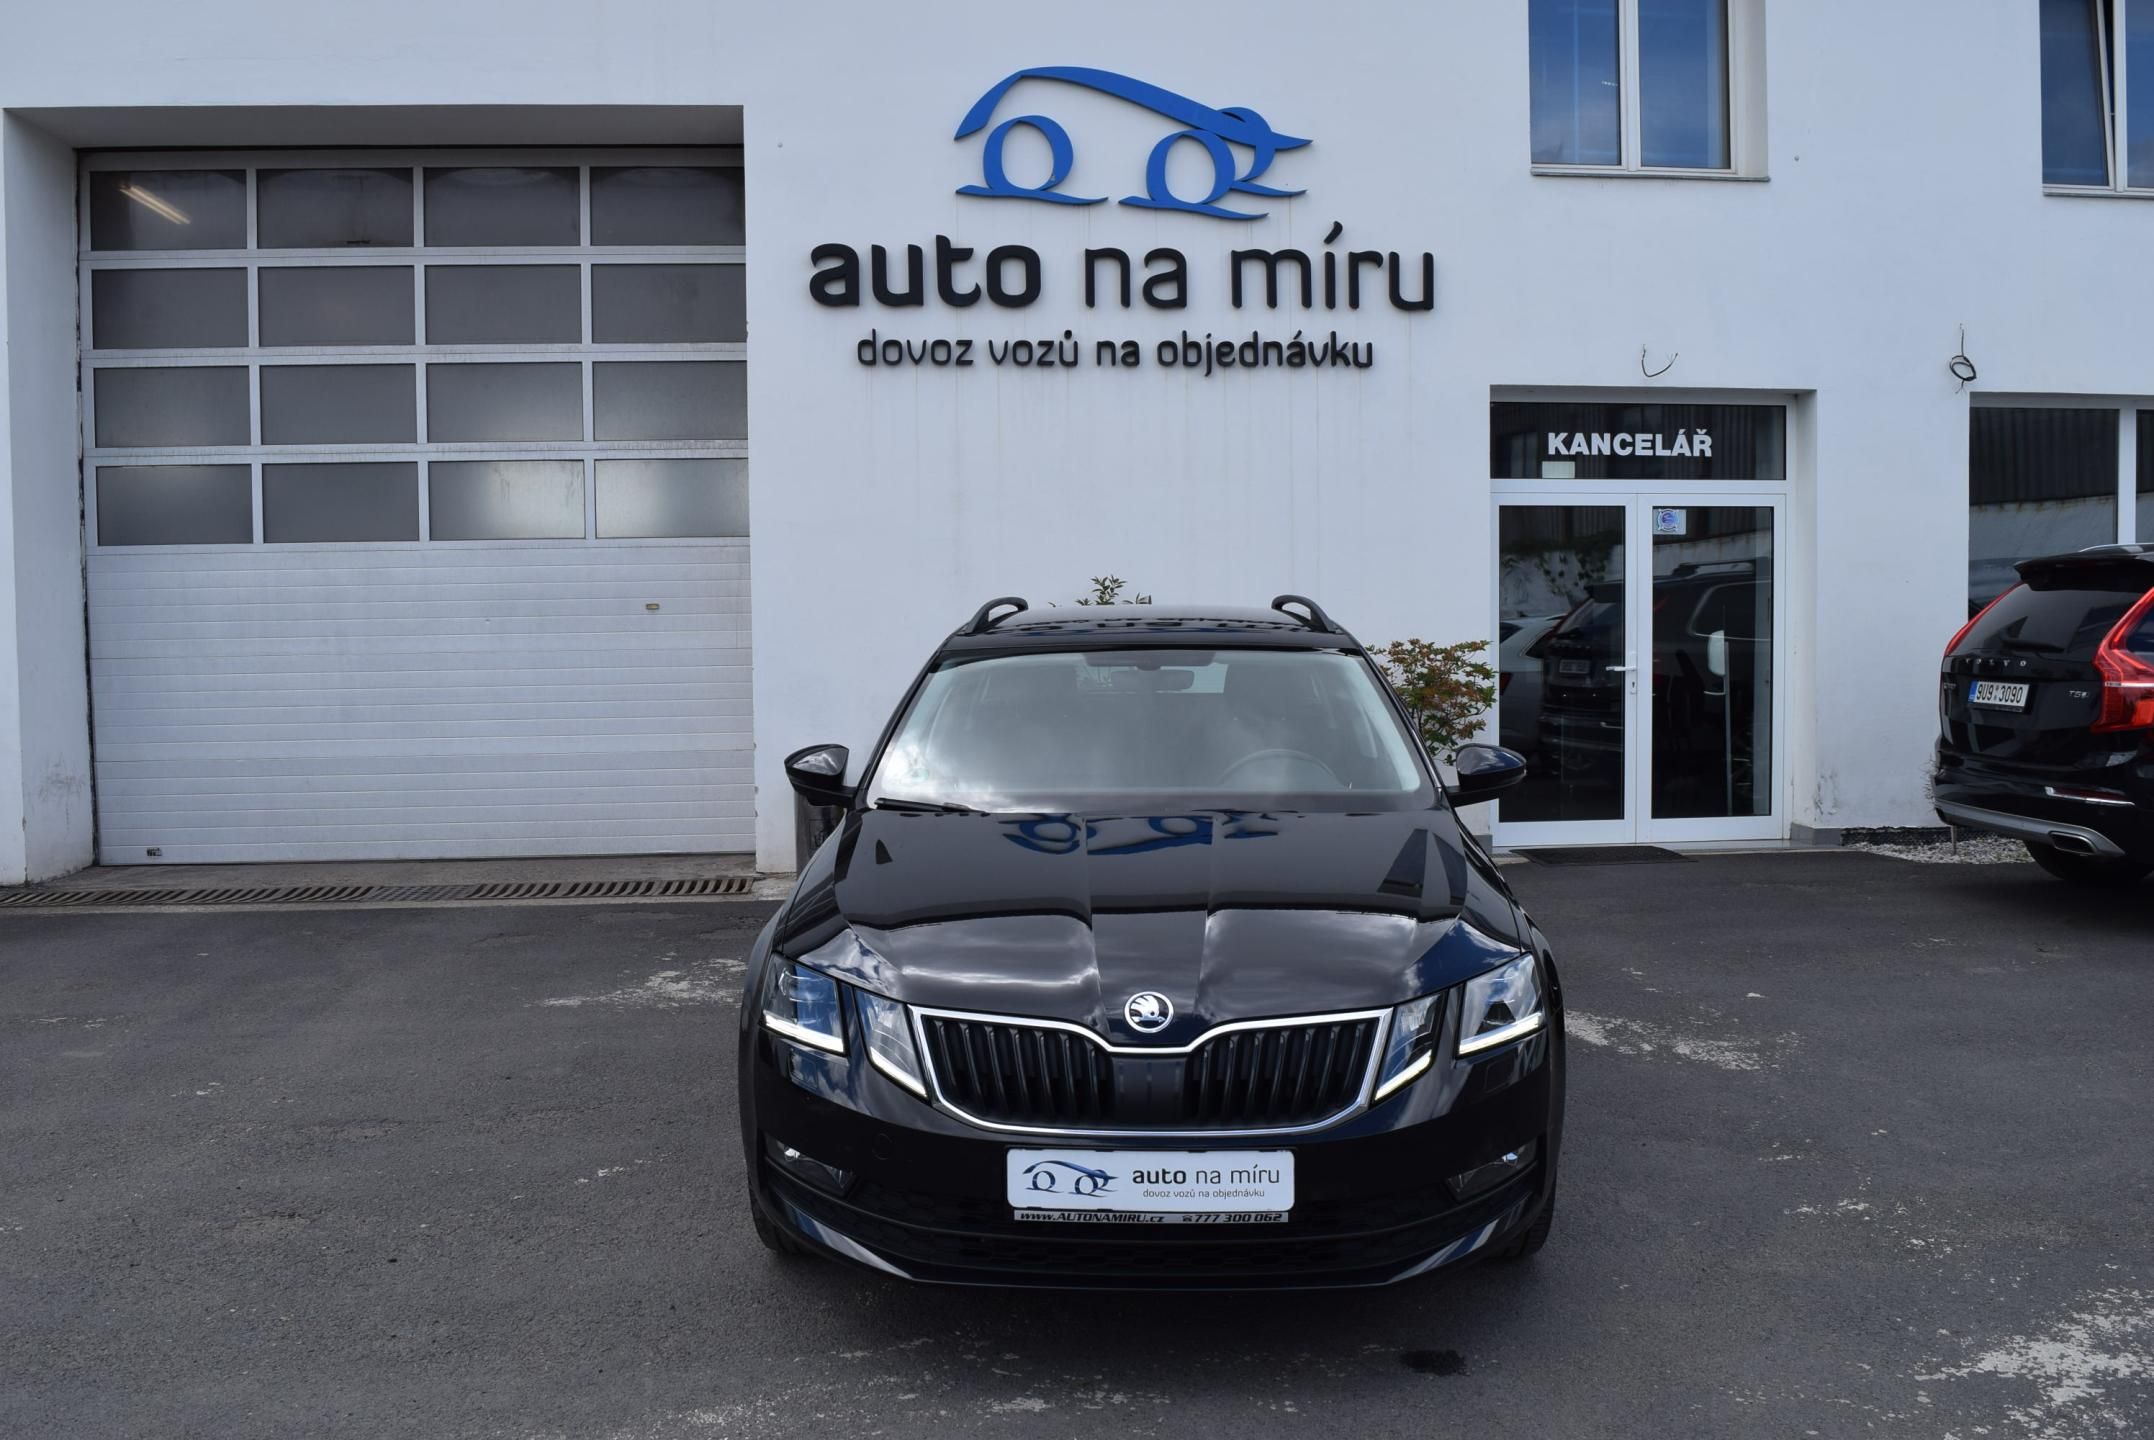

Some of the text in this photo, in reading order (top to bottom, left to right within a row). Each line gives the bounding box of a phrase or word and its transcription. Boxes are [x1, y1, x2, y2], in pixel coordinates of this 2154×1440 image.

[809, 220, 1435, 314] auto na míru
[857, 328, 1378, 378] dovoz vozů na objednávku
[1547, 428, 1713, 457] KANCELÁŘ
[1998, 685, 2024, 704] 3090
[1132, 1163, 1280, 1185] auto na míru
[1142, 1188, 1265, 1199] dovoz vozů na objednávku
[1019, 1212, 1282, 1223] www.AUTONAMIRU.cz 777 300 062
